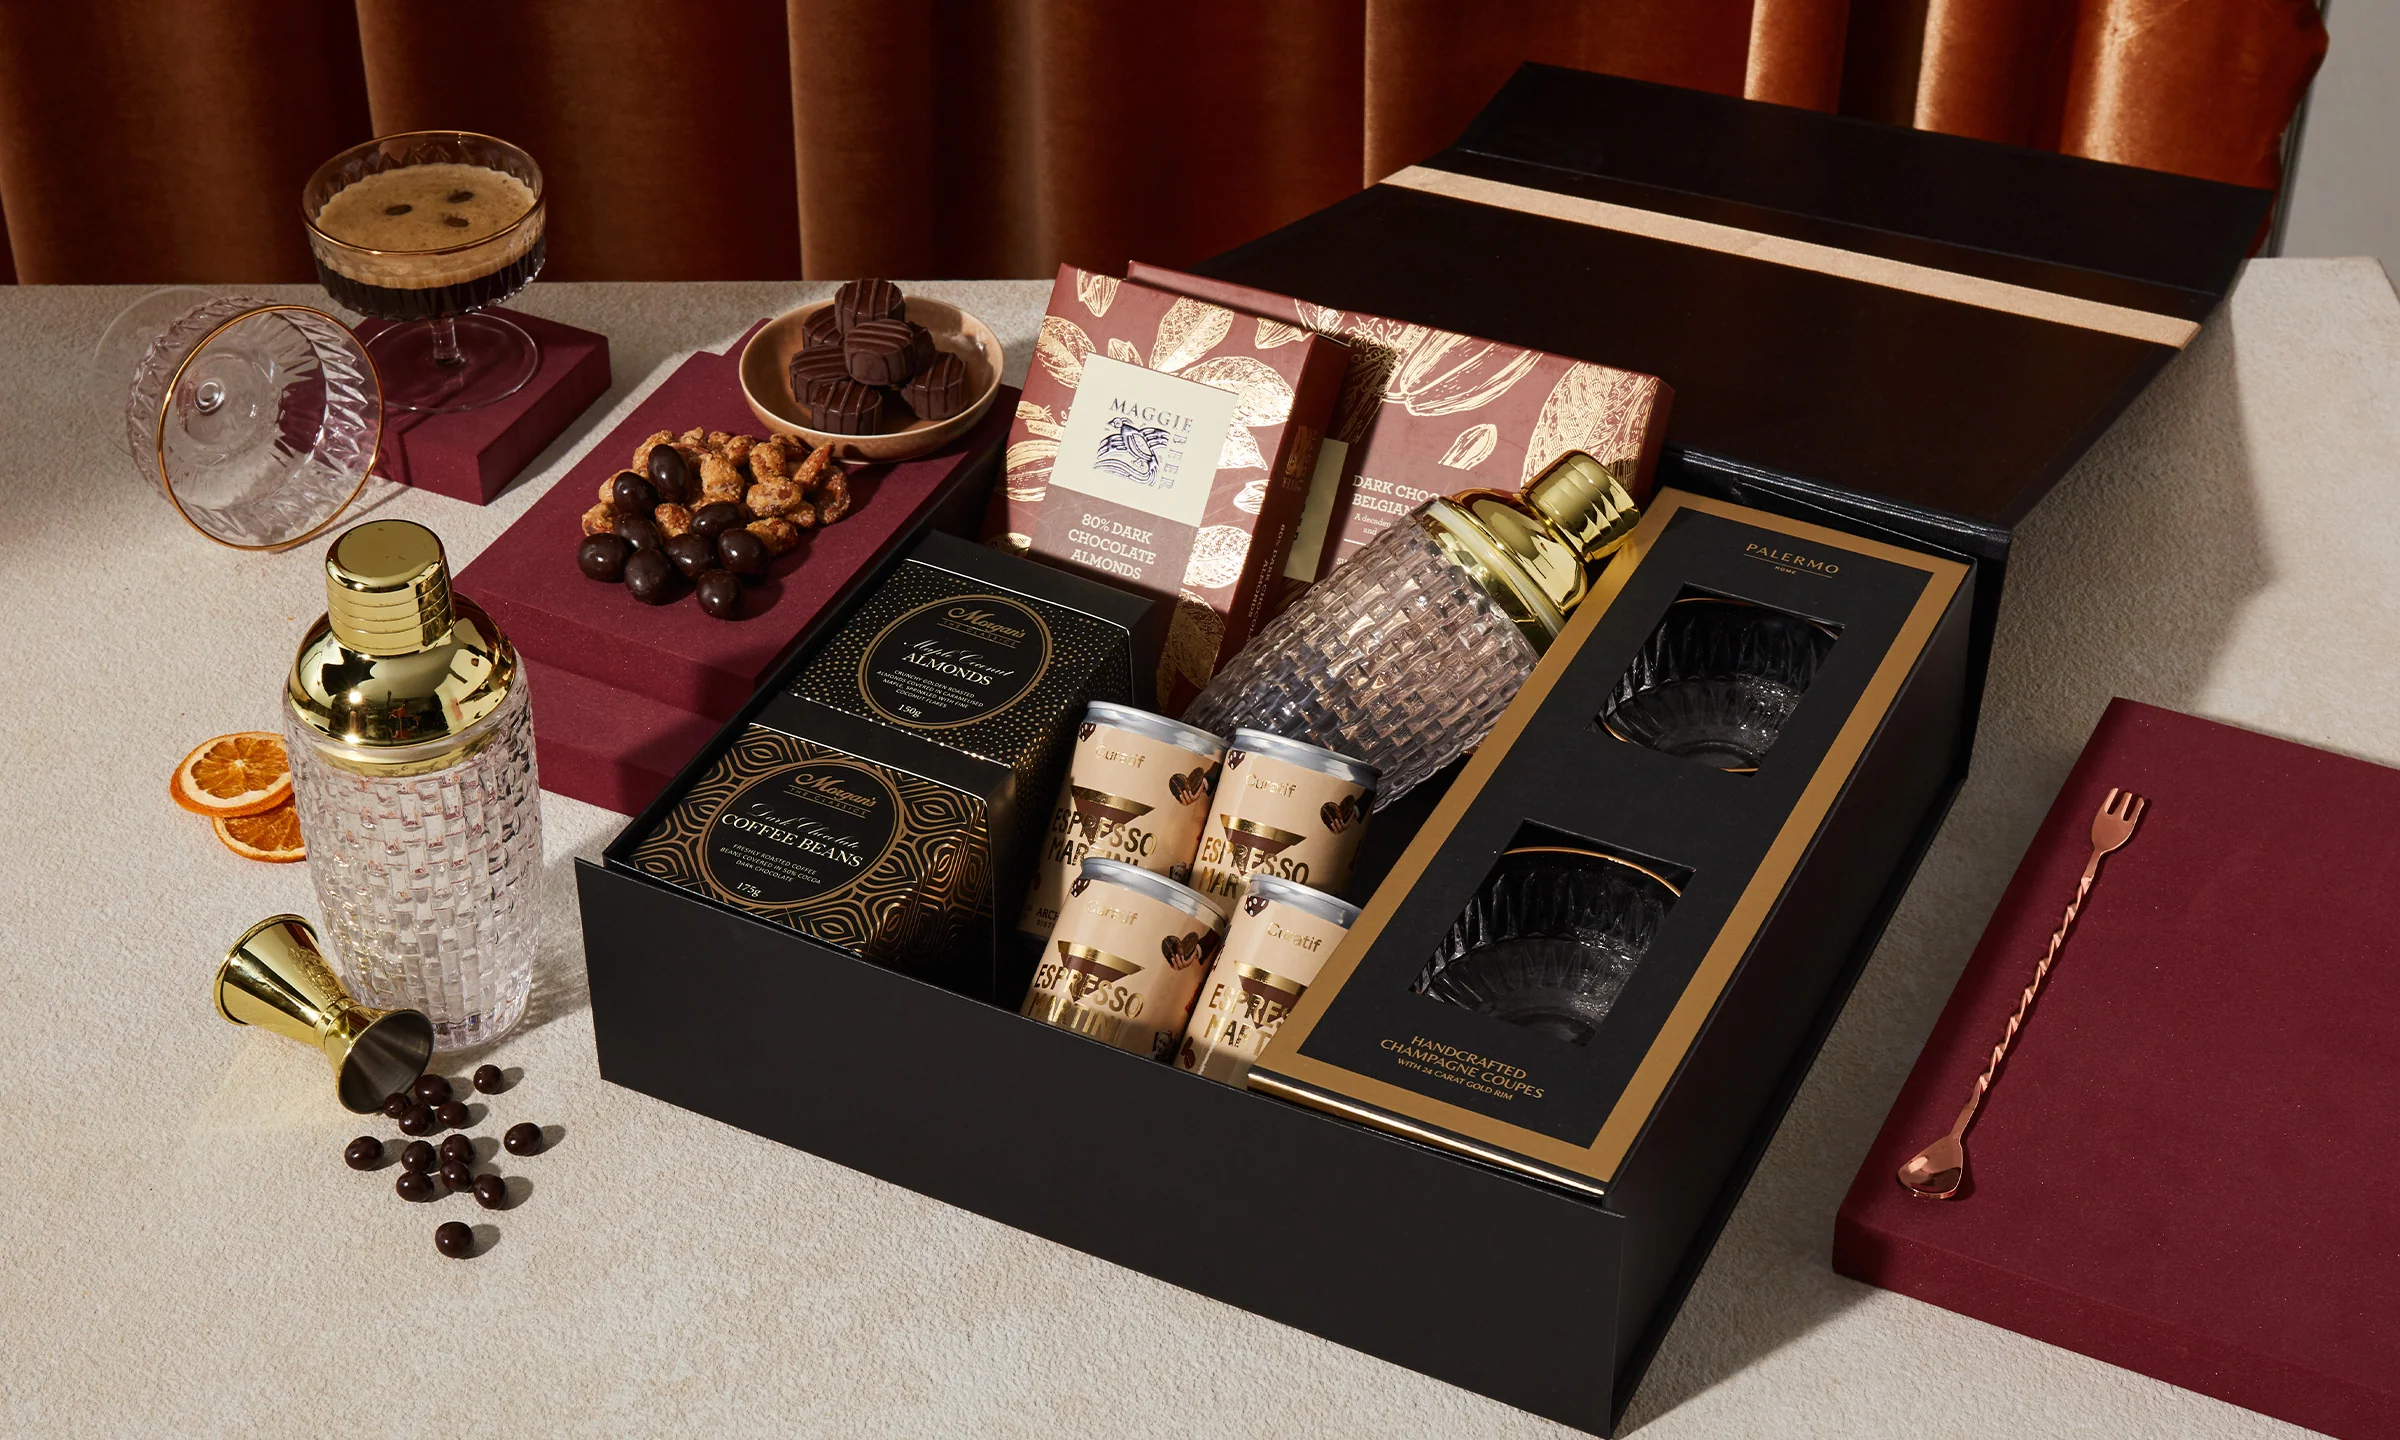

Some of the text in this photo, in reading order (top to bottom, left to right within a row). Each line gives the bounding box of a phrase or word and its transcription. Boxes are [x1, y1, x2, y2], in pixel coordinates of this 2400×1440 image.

[1109, 398, 1193, 433] MAGGIE
[1158, 434, 1188, 490] BEER
[1353, 475, 1394, 495] DARK
[1082, 513, 1153, 544] 80% DARK
[1363, 527, 1377, 536] and
[1068, 529, 1156, 565] CHOCOLATE
[1746, 543, 1839, 574] PALERMO
[1070, 549, 1142, 580] ALMONDS
[1775, 566, 1797, 575] HOME
[948, 607, 1026, 639] Morgan's
[894, 670, 975, 698] CRUNCHY GOLDEN ROASTED
[902, 652, 993, 686] ALMONDS
[876, 670, 984, 707] ALMONDS COVERED IN CARAMELISED
[896, 689, 948, 709] COCONUT FLAKES
[905, 685, 938, 699] SPRINKLED
[938, 695, 955, 705] WITH
[955, 701, 969, 709] FINE
[898, 704, 922, 718] 150g
[1096, 744, 1145, 769] Curatif
[795, 773, 877, 807] Morgan's
[1246, 773, 1296, 798] Curatif
[722, 813, 864, 868] COFFEE BEANS
[746, 803, 860, 849] Dark Chocolate
[1052, 807, 1158, 857] ESPRESSO
[720, 847, 742, 858] BEANS
[742, 854, 773, 868] COVERED
[782, 868, 797, 876] 50%
[797, 873, 821, 884] COCOA
[733, 844, 817, 875] FRESHLY ROASTED COFFEE
[736, 860, 794, 883] DARK CHOCOLATE
[1201, 837, 1310, 885] ESPRESSO
[737, 882, 762, 898] 175g
[1087, 899, 1139, 926] Curatif
[1267, 922, 1322, 952] Curatif
[1034, 964, 1144, 1019] ESPRESSO
[1028, 992, 1127, 1045] MARTINI
[1380, 1039, 1545, 1099] CHAMPAGNE COUPES
[1411, 1035, 1527, 1079] HANDCRAFTED
[1398, 1058, 1513, 1101] WITH 24 CARAT GOLD RIM
